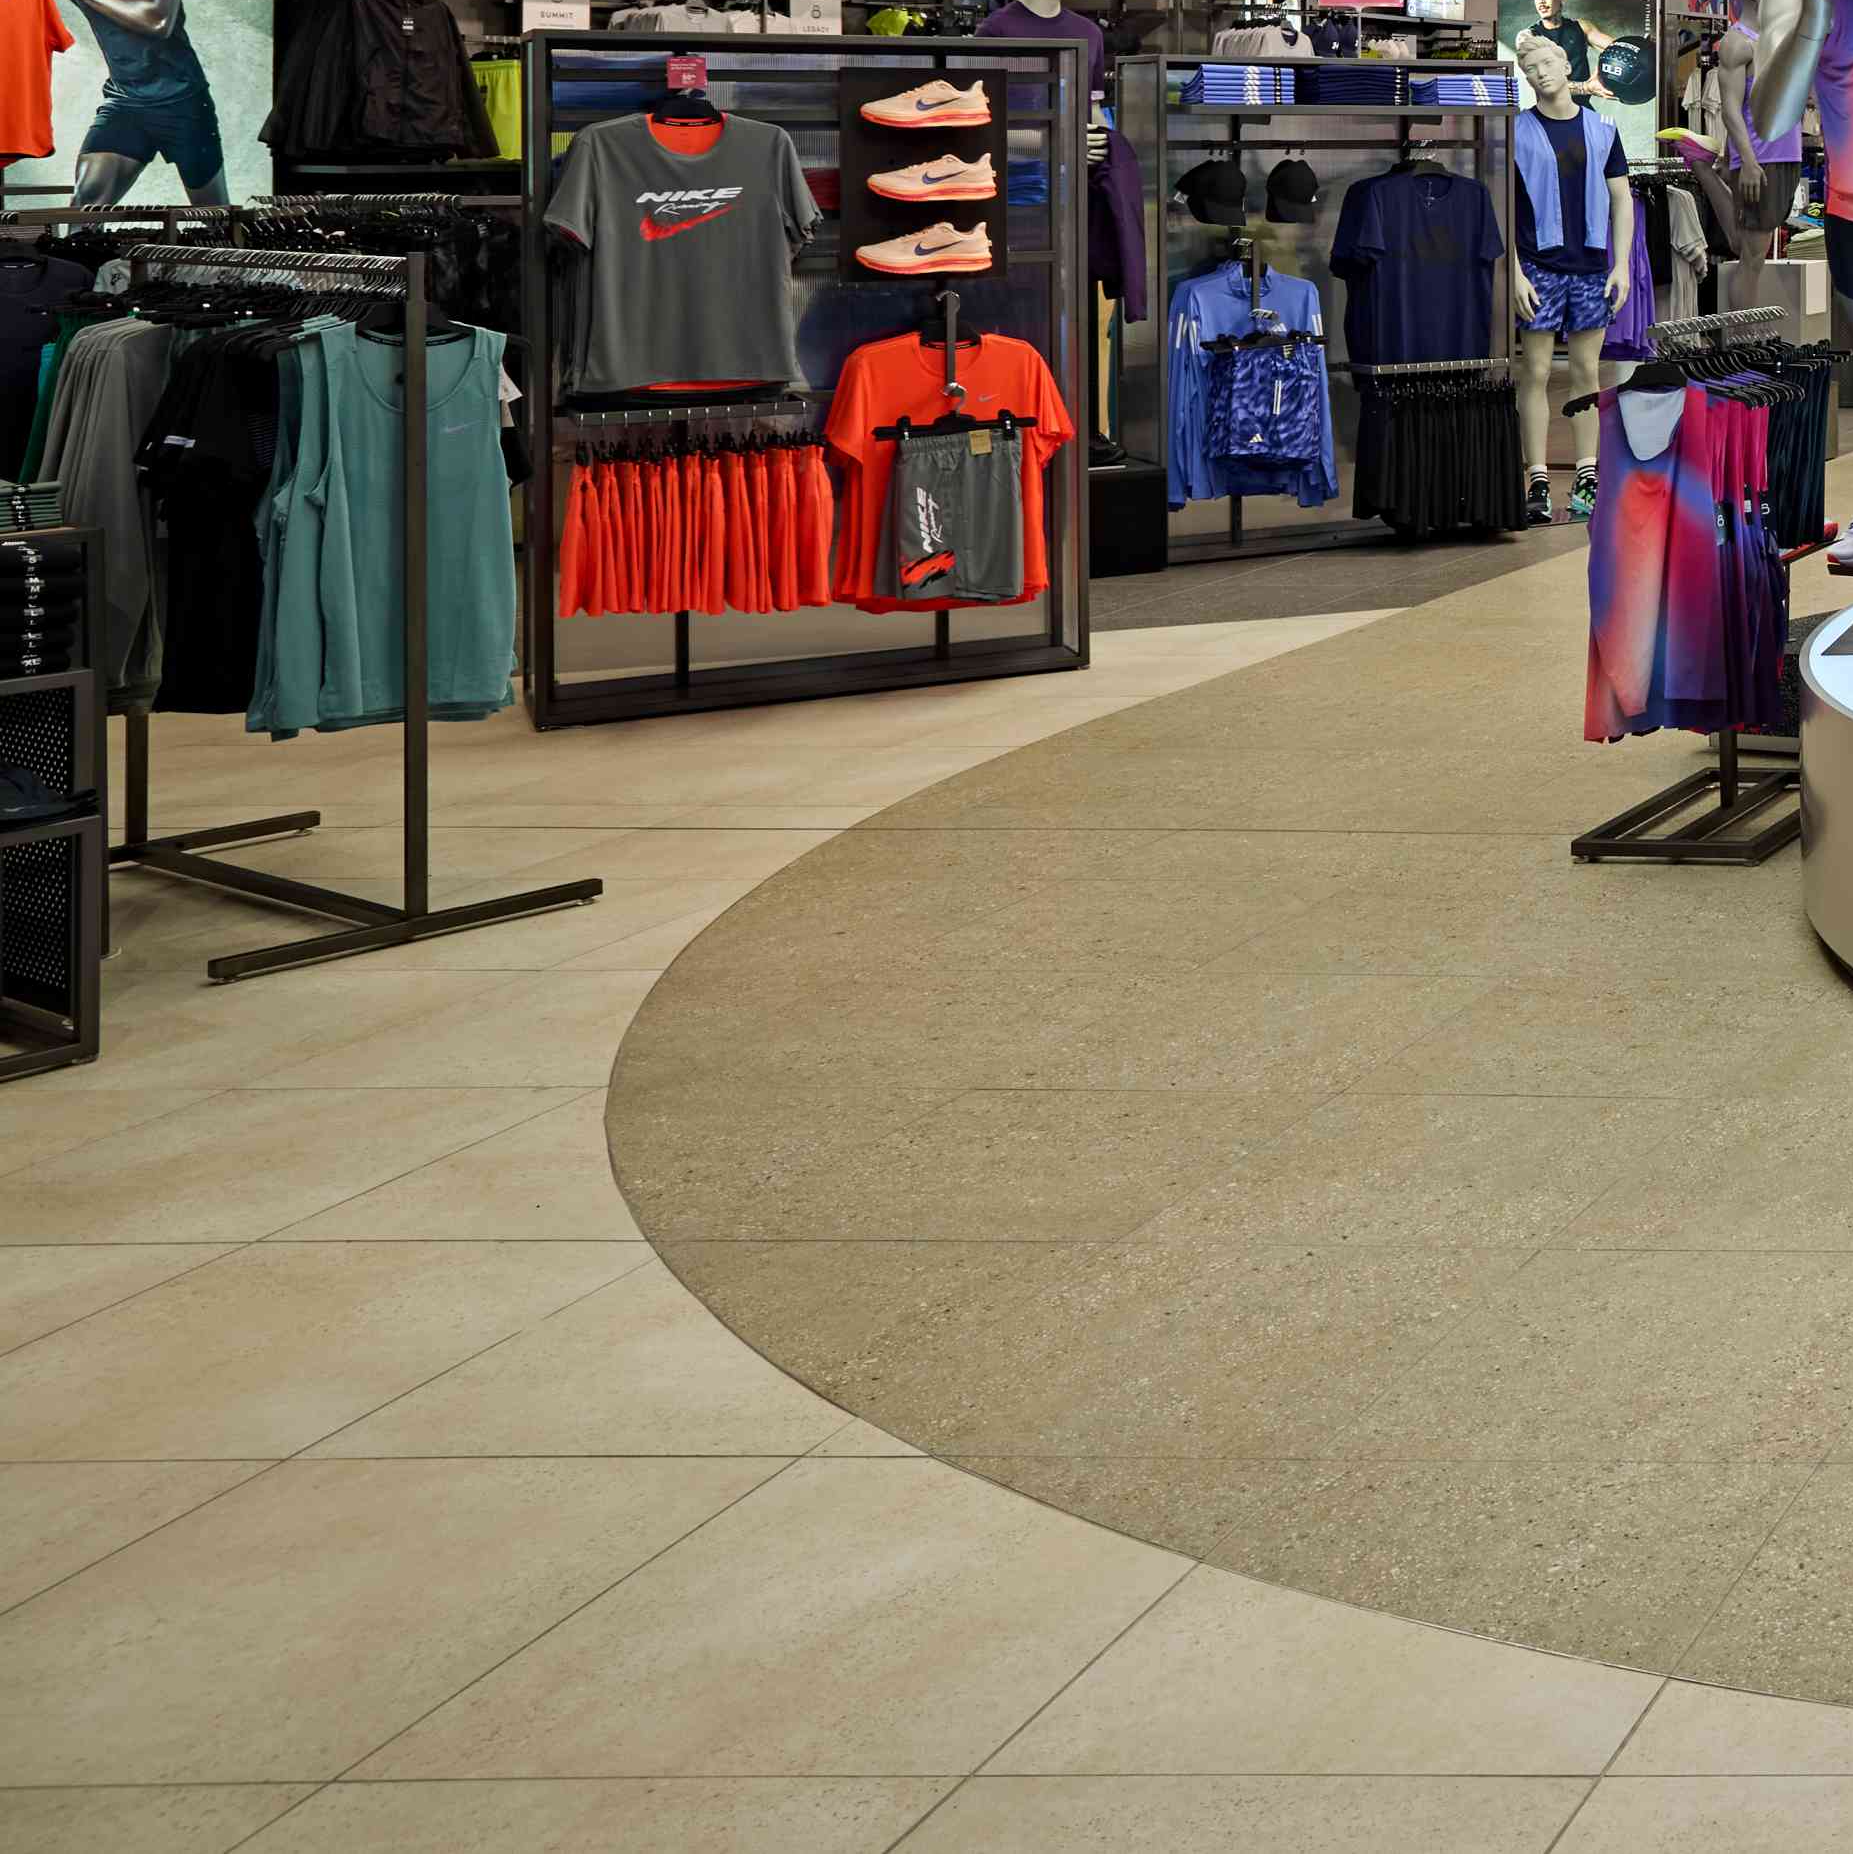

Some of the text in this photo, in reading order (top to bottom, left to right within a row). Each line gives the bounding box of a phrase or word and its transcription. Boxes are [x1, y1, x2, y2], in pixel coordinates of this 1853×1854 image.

[540, 10, 574, 19] SUMMIT
[636, 187, 744, 203] NIKE
[654, 201, 728, 216] Running
[916, 486, 934, 554] NIKE
